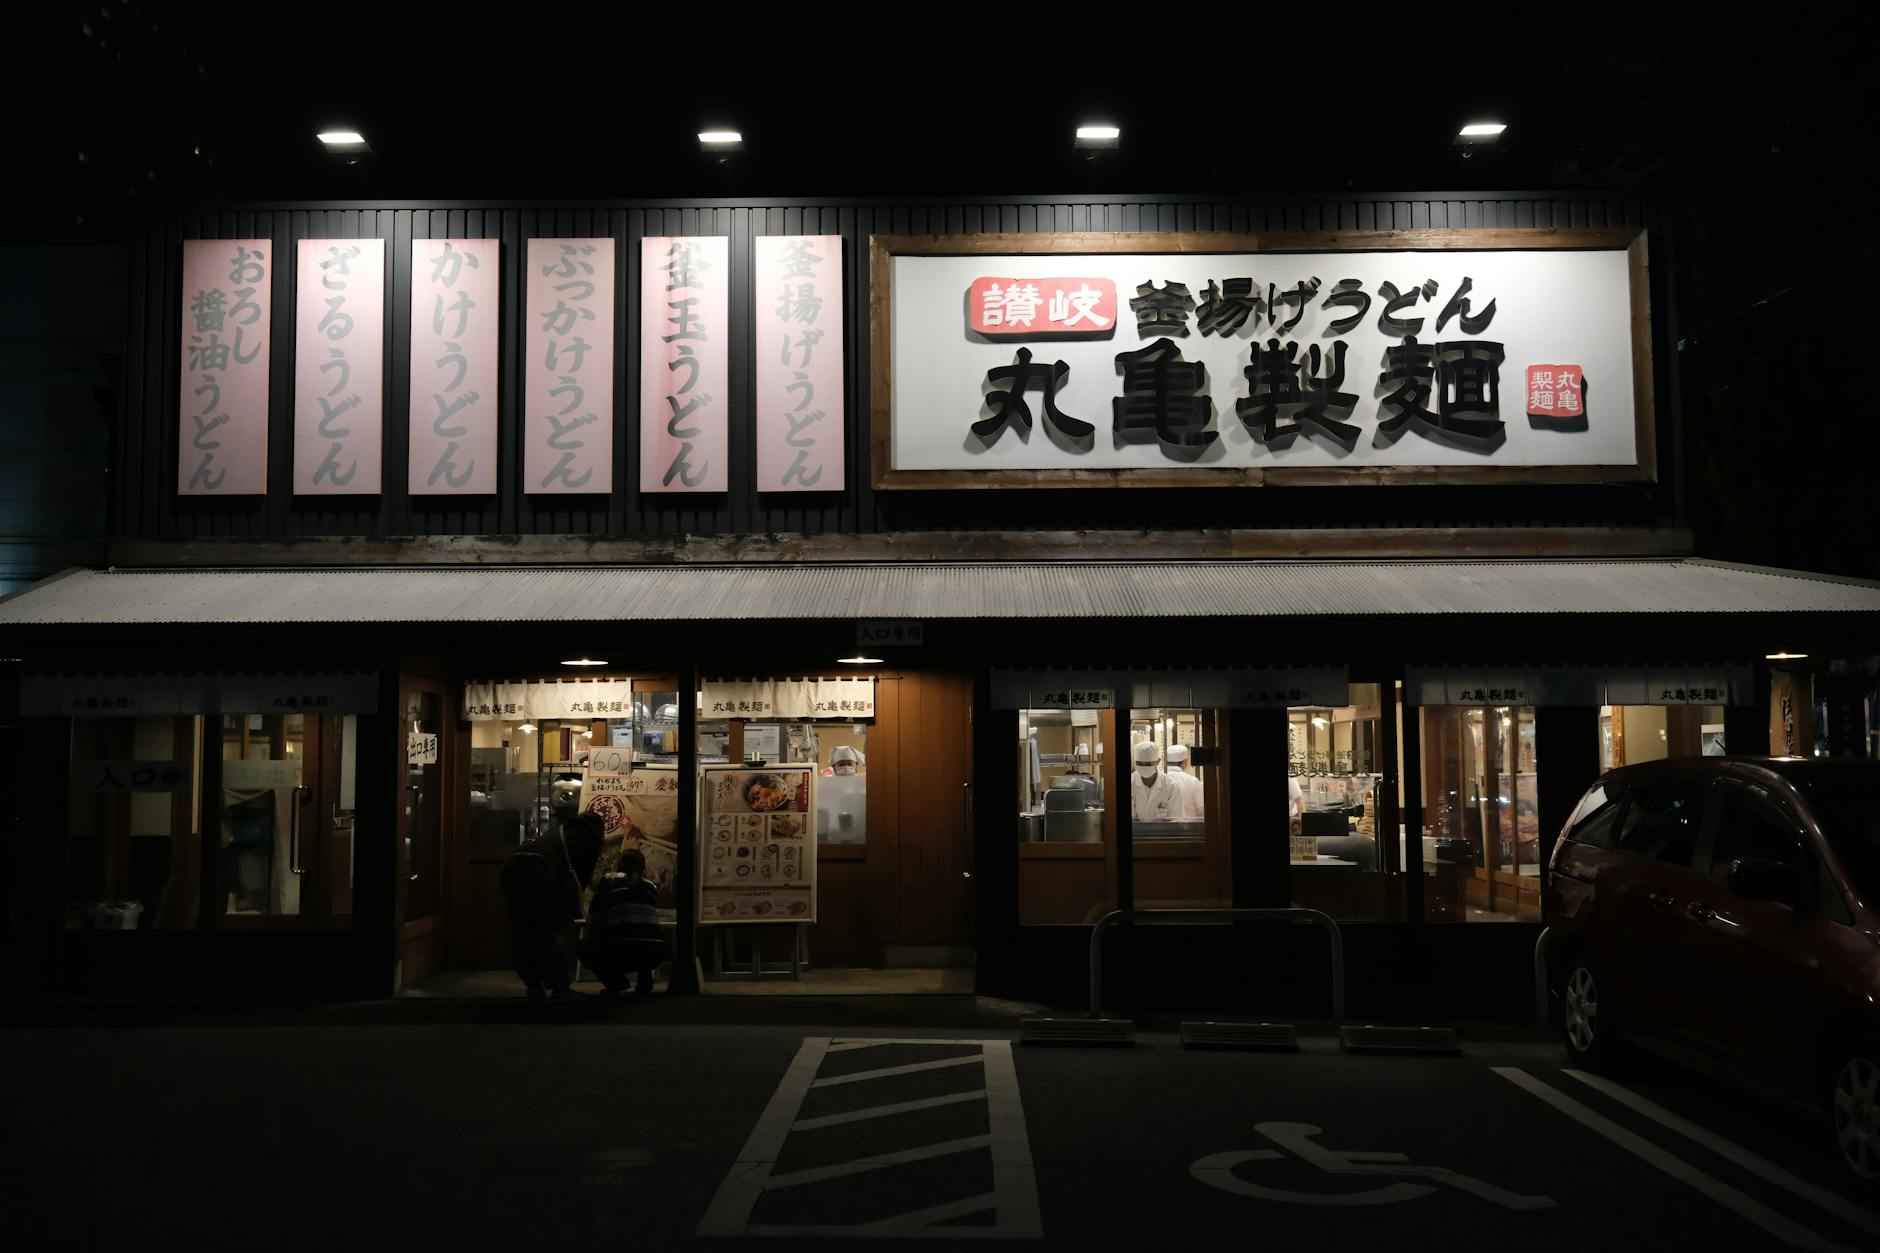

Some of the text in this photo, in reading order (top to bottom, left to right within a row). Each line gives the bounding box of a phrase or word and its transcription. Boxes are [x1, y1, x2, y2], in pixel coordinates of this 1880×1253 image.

[229, 246, 265, 364] おろし
[428, 242, 479, 488] かけうどん
[542, 243, 598, 488] ぶっかけうどん
[661, 242, 713, 488] 釜玉うどん
[776, 239, 825, 487] 釜揚げうどん
[981, 283, 1110, 328] 讃岐
[1129, 276, 1497, 339] 釜揚げうどん
[188, 288, 230, 490] 醤油うどん
[313, 245, 360, 487] ざるうどん
[969, 335, 1507, 460] 丸亀製麺
[1556, 371, 1581, 411] 丸亀
[570, 701, 622, 713] 丸亀製麺
[712, 701, 763, 712] 丸亀製麺
[815, 701, 865, 712] 丸亀製麺
